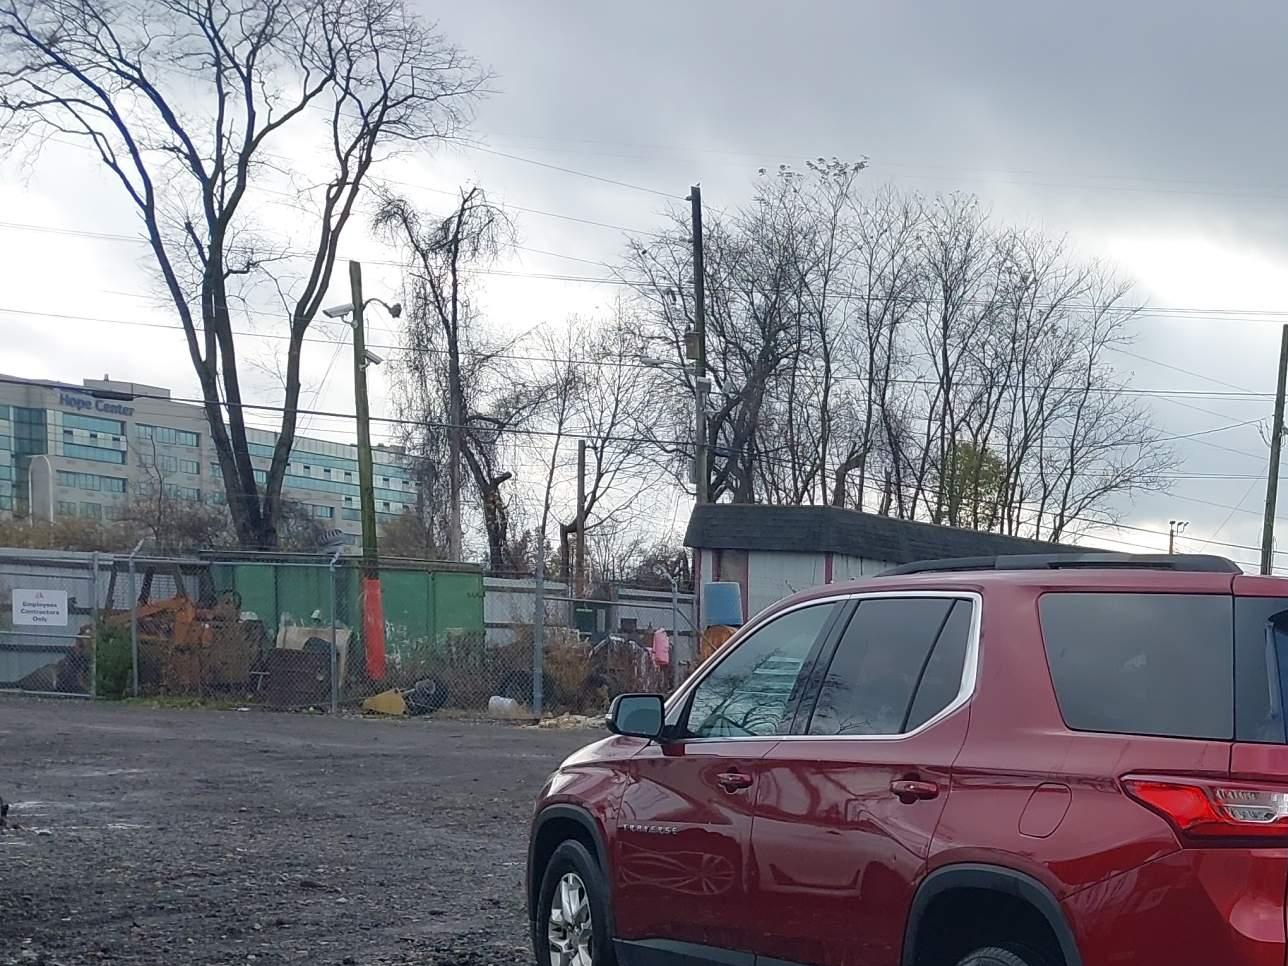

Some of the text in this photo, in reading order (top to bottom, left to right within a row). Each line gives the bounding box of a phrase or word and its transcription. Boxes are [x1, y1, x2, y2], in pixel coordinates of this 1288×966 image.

[59, 393, 135, 416] Hope Center
[623, 823, 678, 835] TRAVERSE
